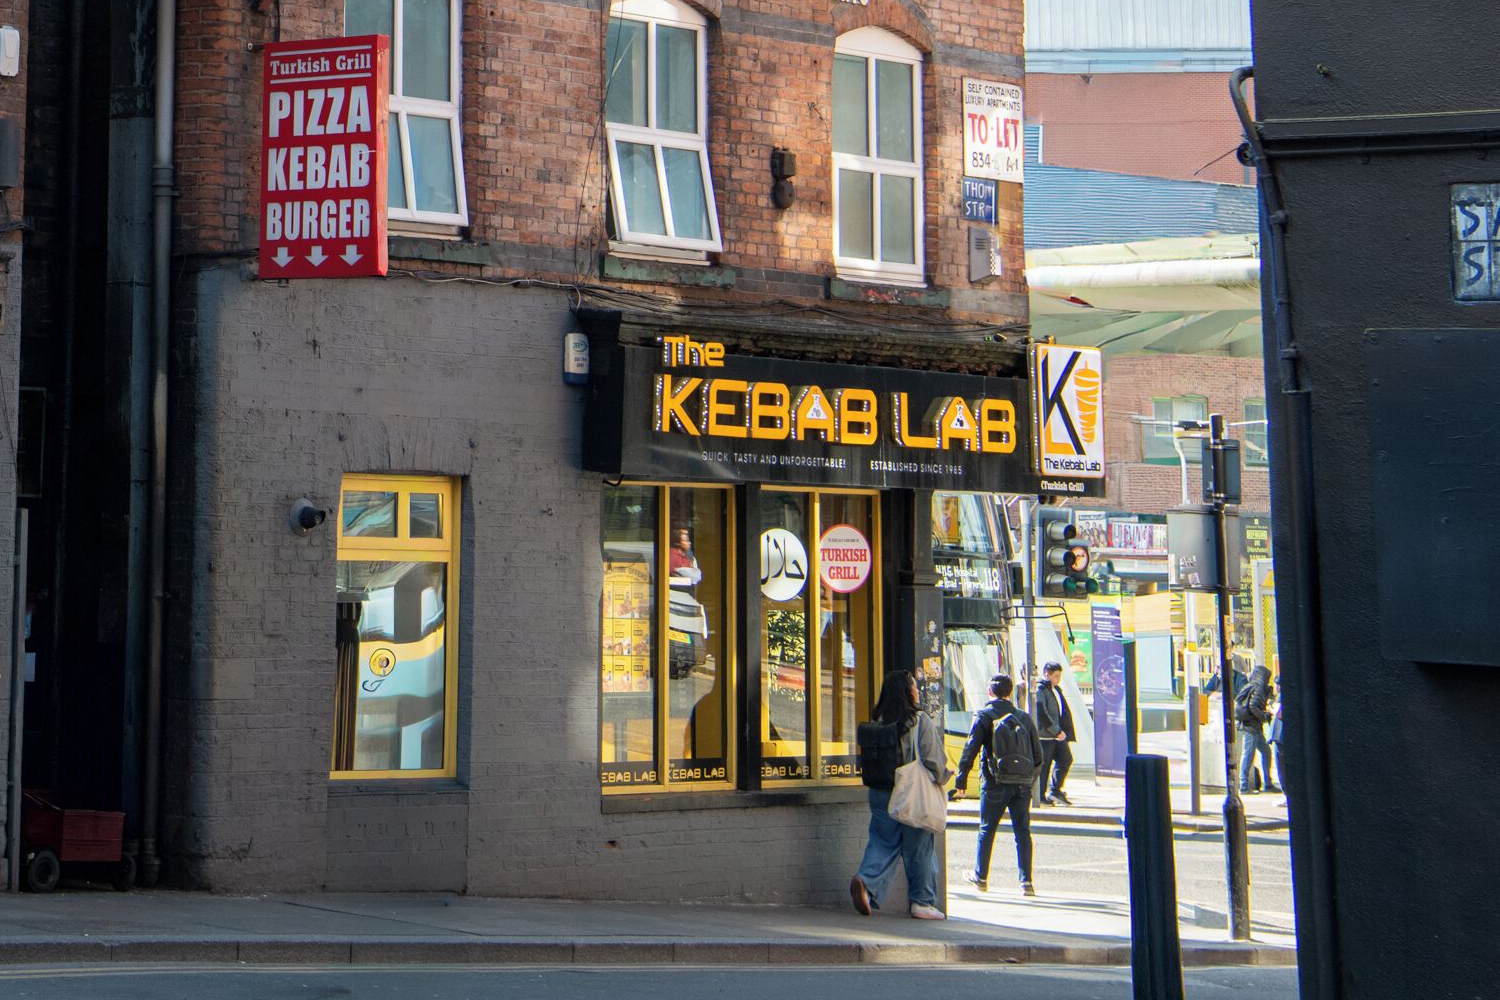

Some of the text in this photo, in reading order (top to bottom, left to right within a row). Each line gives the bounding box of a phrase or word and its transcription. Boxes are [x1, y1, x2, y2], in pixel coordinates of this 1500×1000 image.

[270, 53, 371, 75] Turkish Grill
[967, 83, 1020, 100] SELF CONTAINED
[269, 85, 372, 138] PIZZA
[965, 94, 1021, 112] LUXURY APARTMENTS
[267, 143, 370, 191] KEBAB
[266, 198, 370, 241] BURGER
[662, 335, 725, 367] The
[657, 374, 1017, 454] KEBAB LAB
[734, 452, 758, 464] TASTY
[760, 454, 777, 465] AND
[779, 455, 846, 469] UNFORGETTABLE!
[870, 460, 918, 473] ESTABLISHED
[920, 463, 943, 474] SINCE
[1044, 458, 1101, 472] The Kebab Lab
[820, 548, 867, 562] TURKISH
[828, 566, 860, 580] GRILL
[601, 770, 656, 783] EBAB LAB
[704, 767, 725, 778] LAB
[760, 765, 810, 777] EBAB LAB
